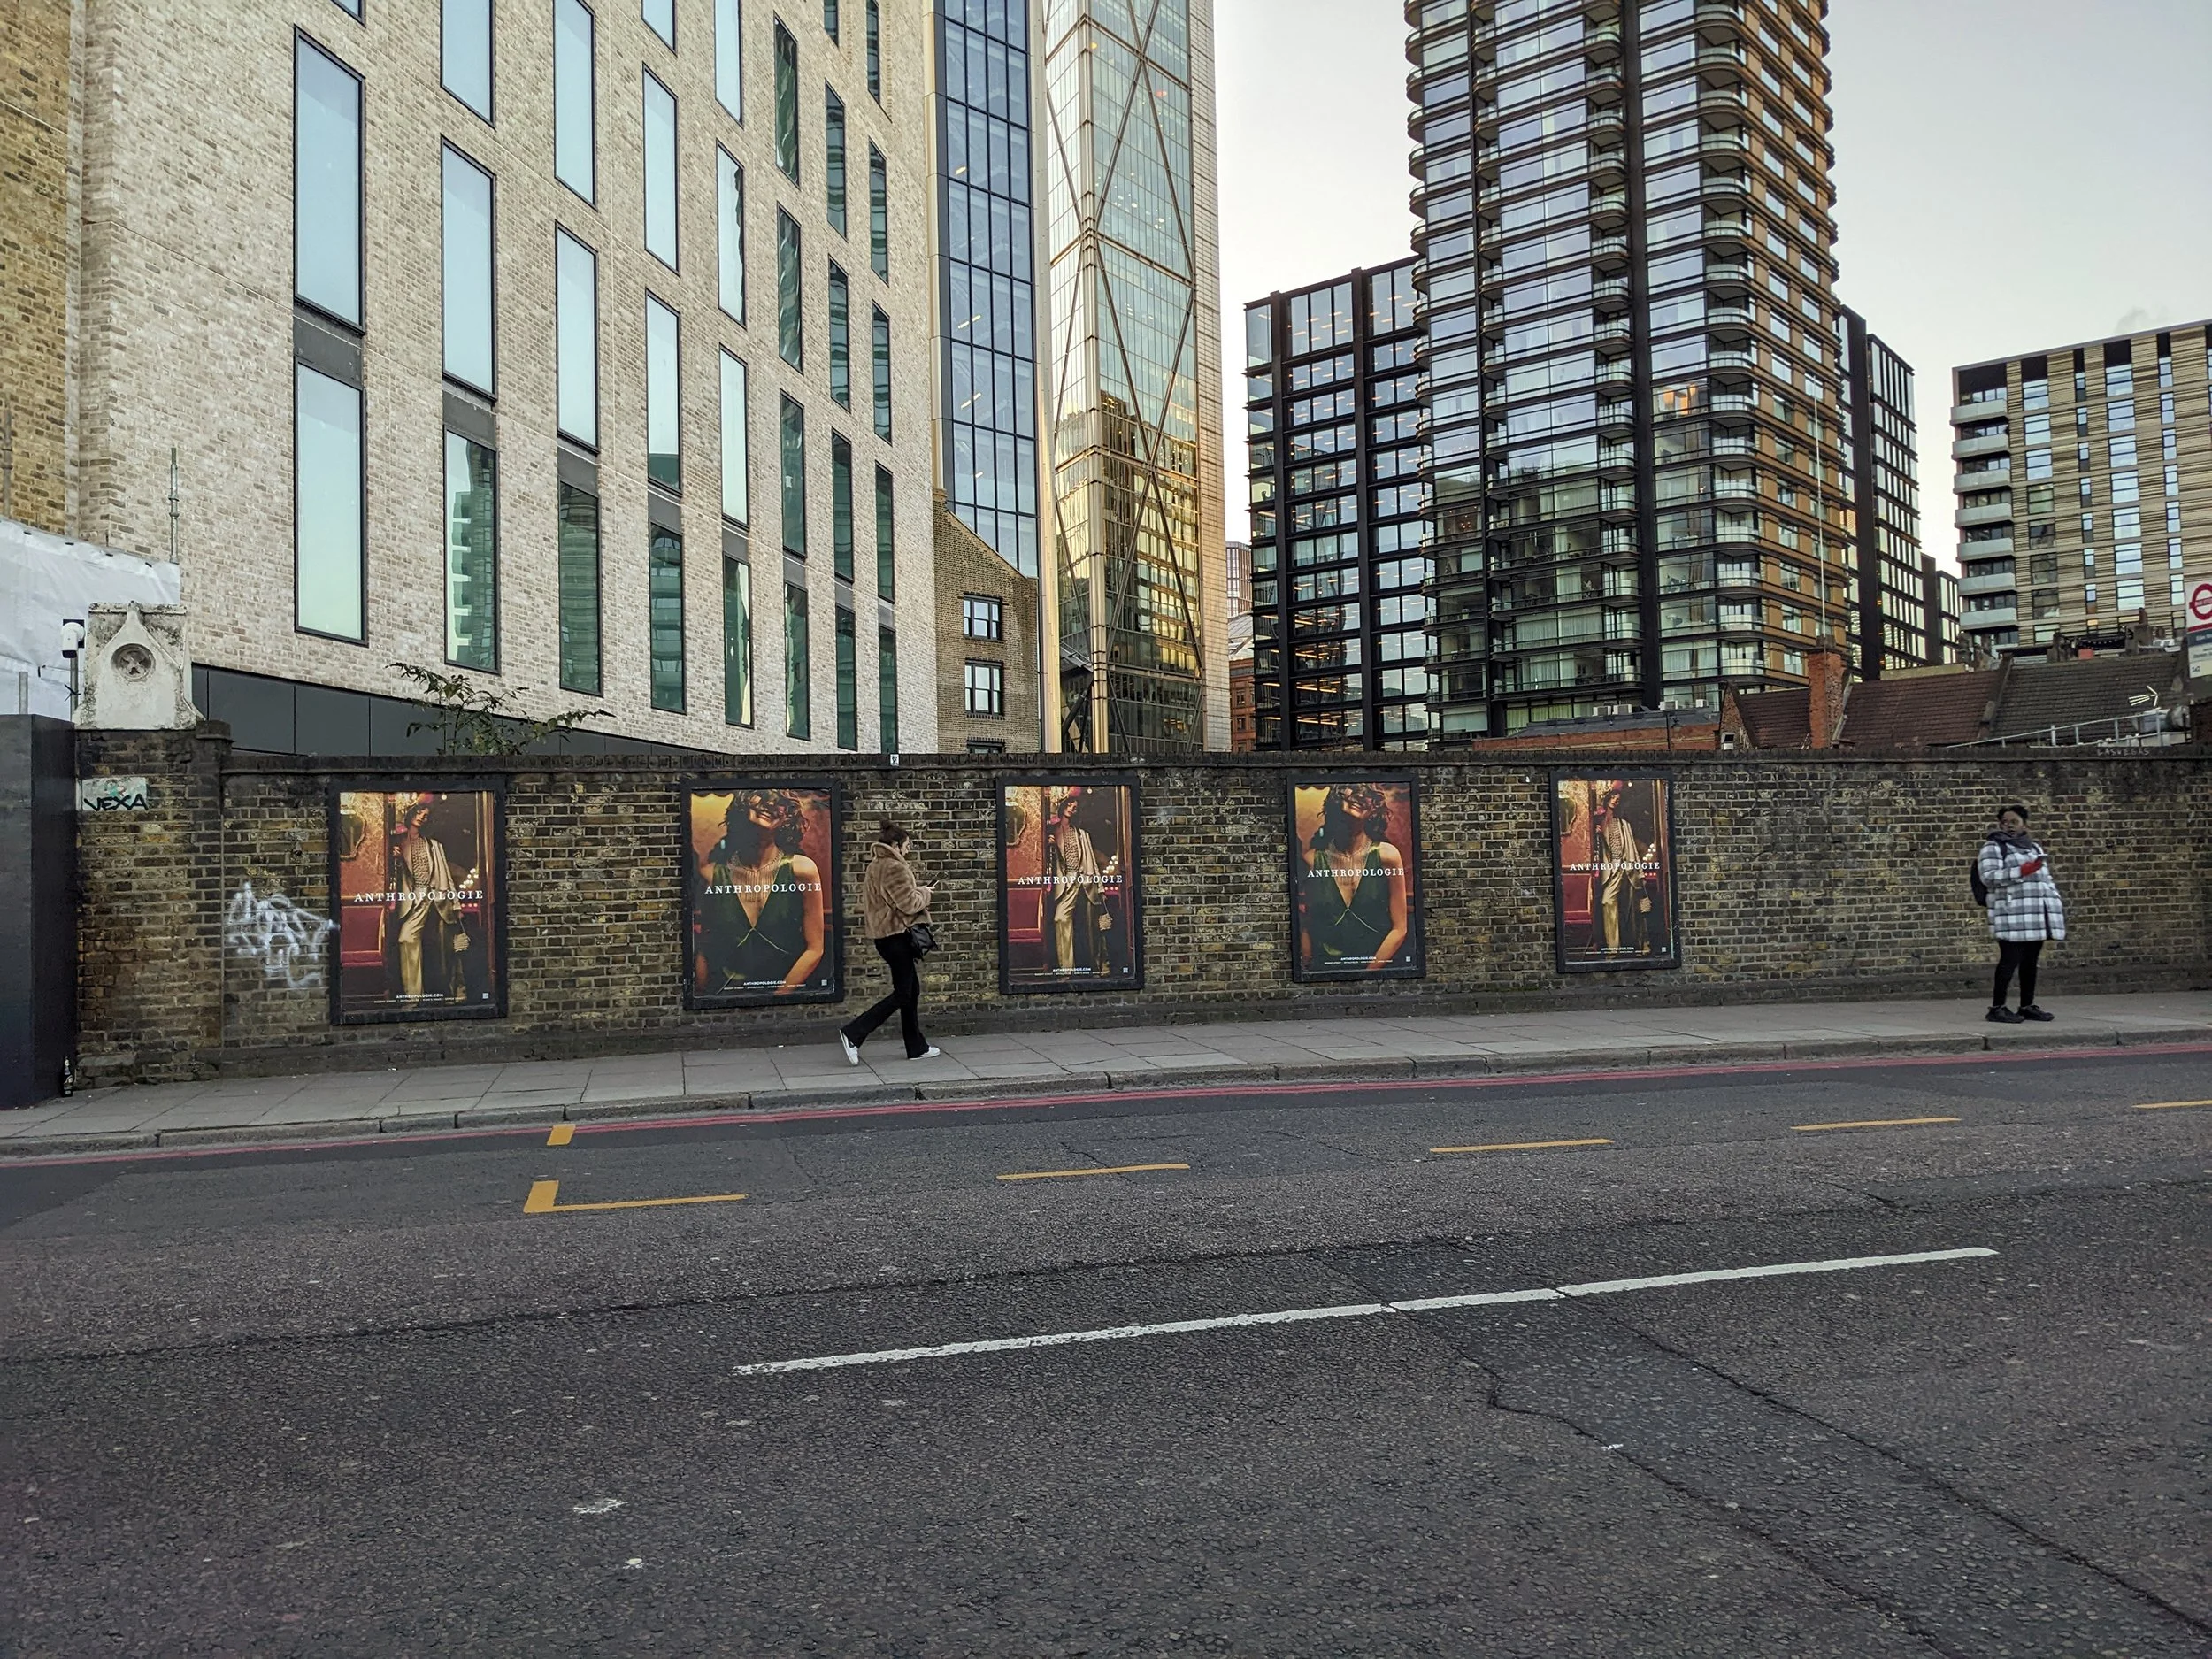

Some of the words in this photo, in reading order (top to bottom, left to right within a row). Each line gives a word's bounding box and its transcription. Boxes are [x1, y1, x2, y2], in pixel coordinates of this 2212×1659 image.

[83, 793, 150, 812] VEXA
[1307, 867, 1405, 878] ANTHROPOLOGIE
[1570, 862, 1661, 872] ANTHROPOLOGIE
[1018, 874, 1123, 886] ANTHROPOLOGIE
[704, 882, 822, 895] ANTHROPOLOGIE
[354, 890, 483, 902] ANTHROPOLOGIE
